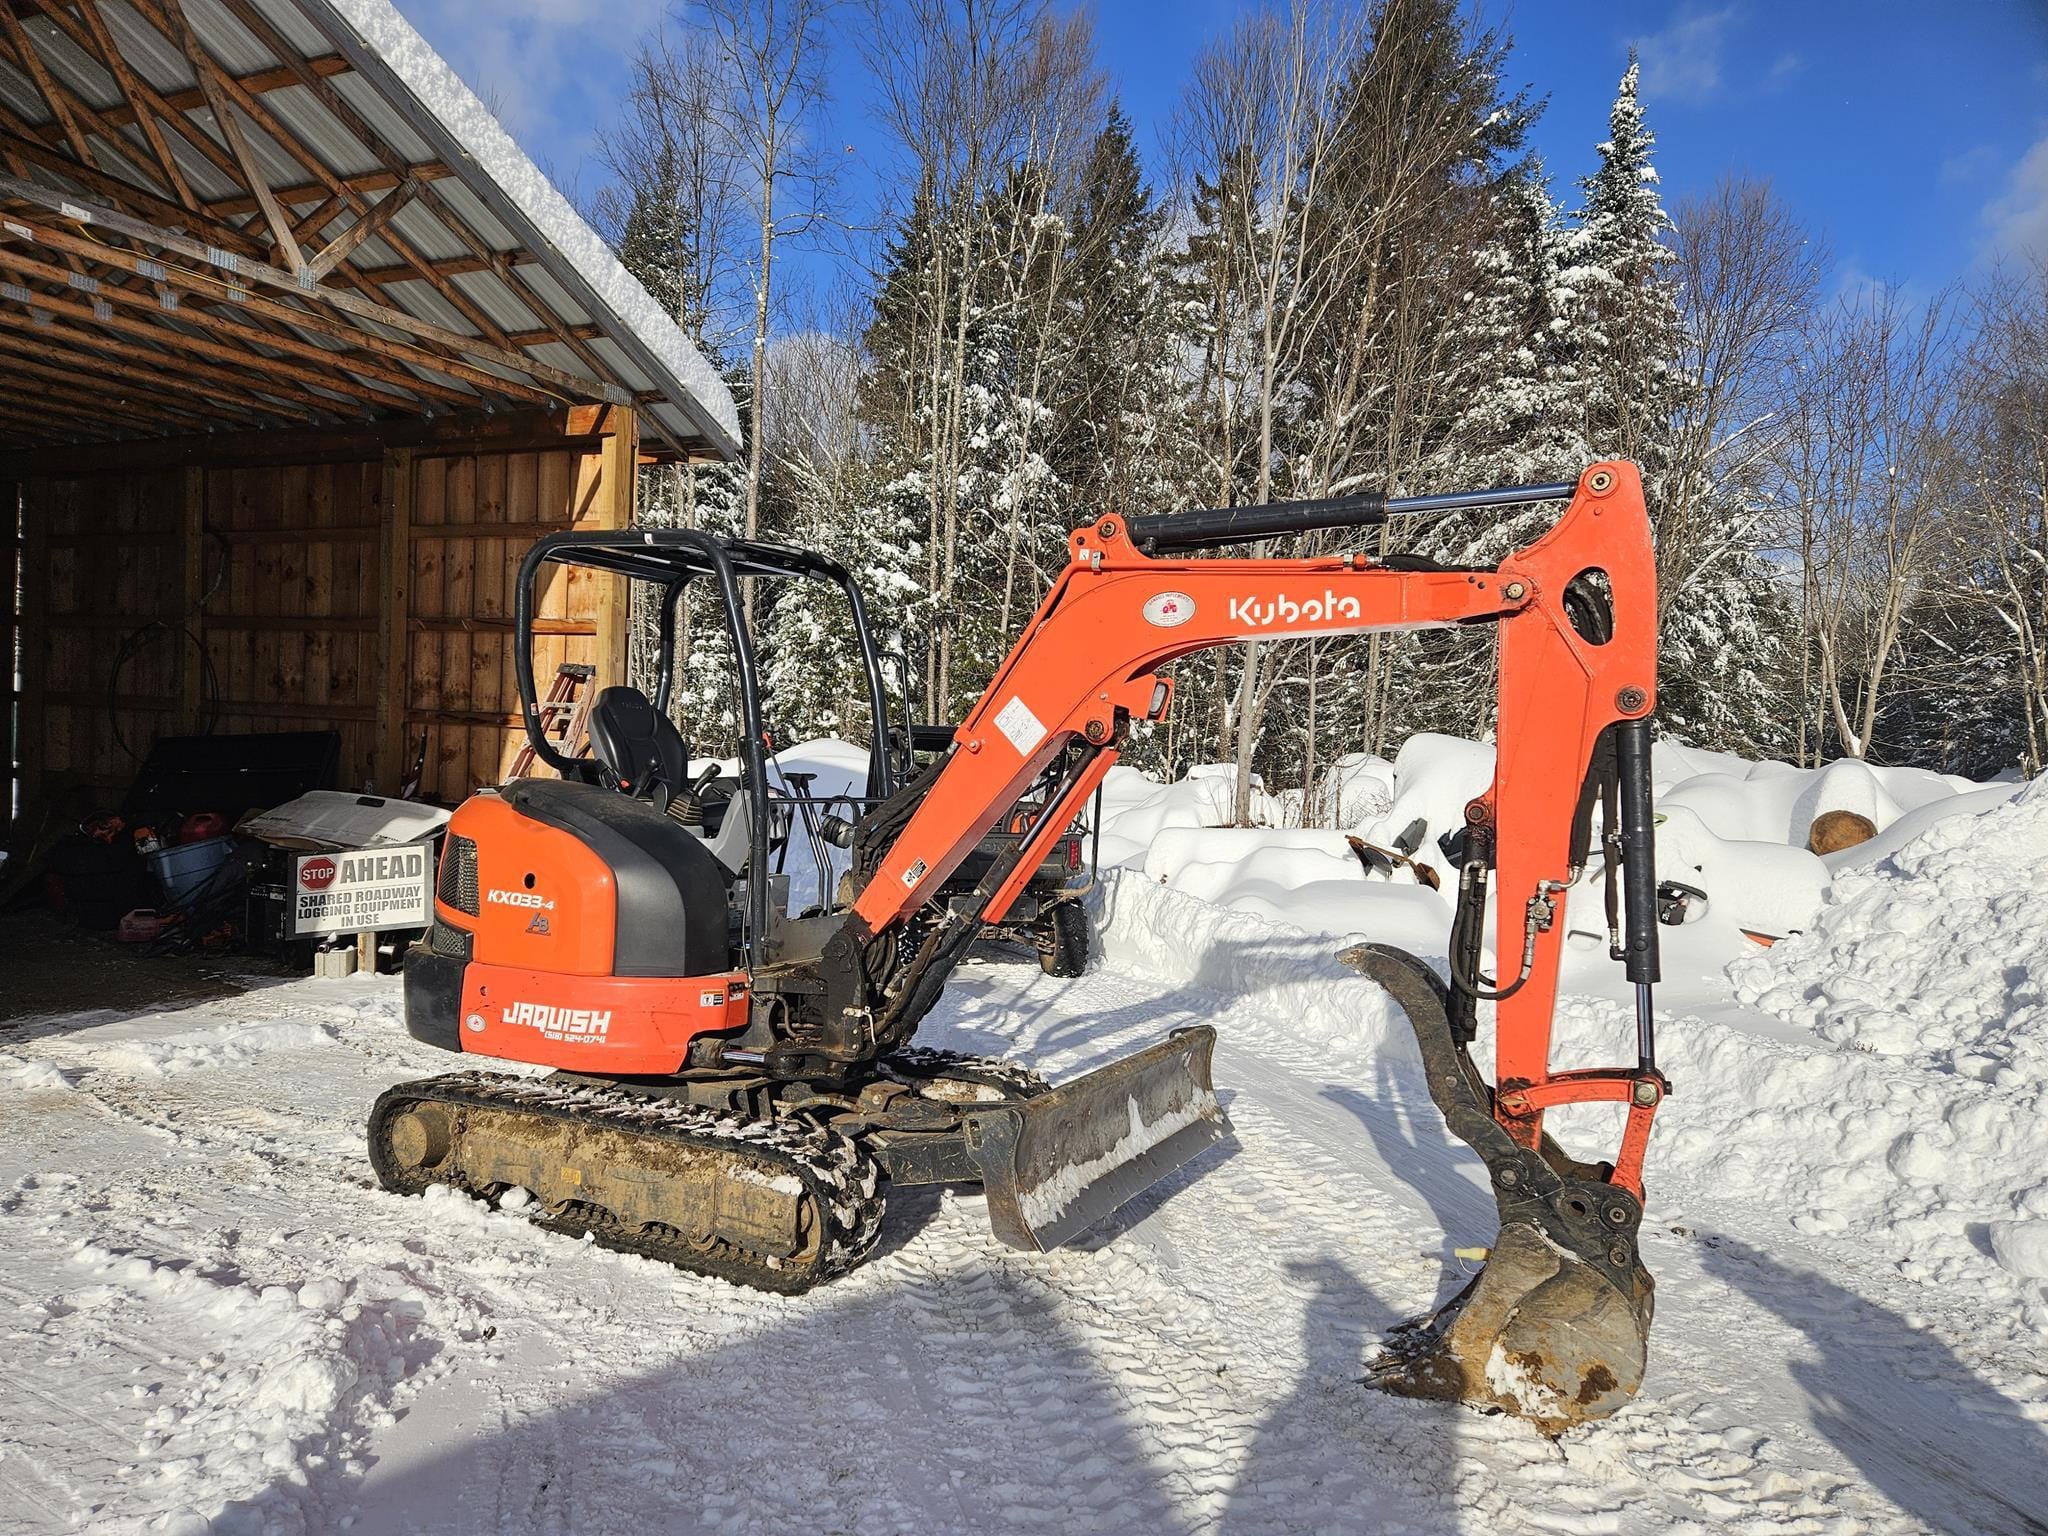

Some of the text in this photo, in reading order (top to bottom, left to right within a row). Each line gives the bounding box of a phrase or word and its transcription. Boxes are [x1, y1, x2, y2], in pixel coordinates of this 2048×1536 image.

[1229, 589, 1361, 626] Kubota
[302, 867, 334, 881] STOP
[340, 854, 422, 884] AHEAD
[300, 886, 422, 908] SHARED ROADWAY
[487, 889, 555, 911] KX033-4
[298, 898, 422, 920] LOGGING EQUIPMENT
[341, 914, 380, 927] IN USE
[502, 1001, 612, 1034] JAQUISH
